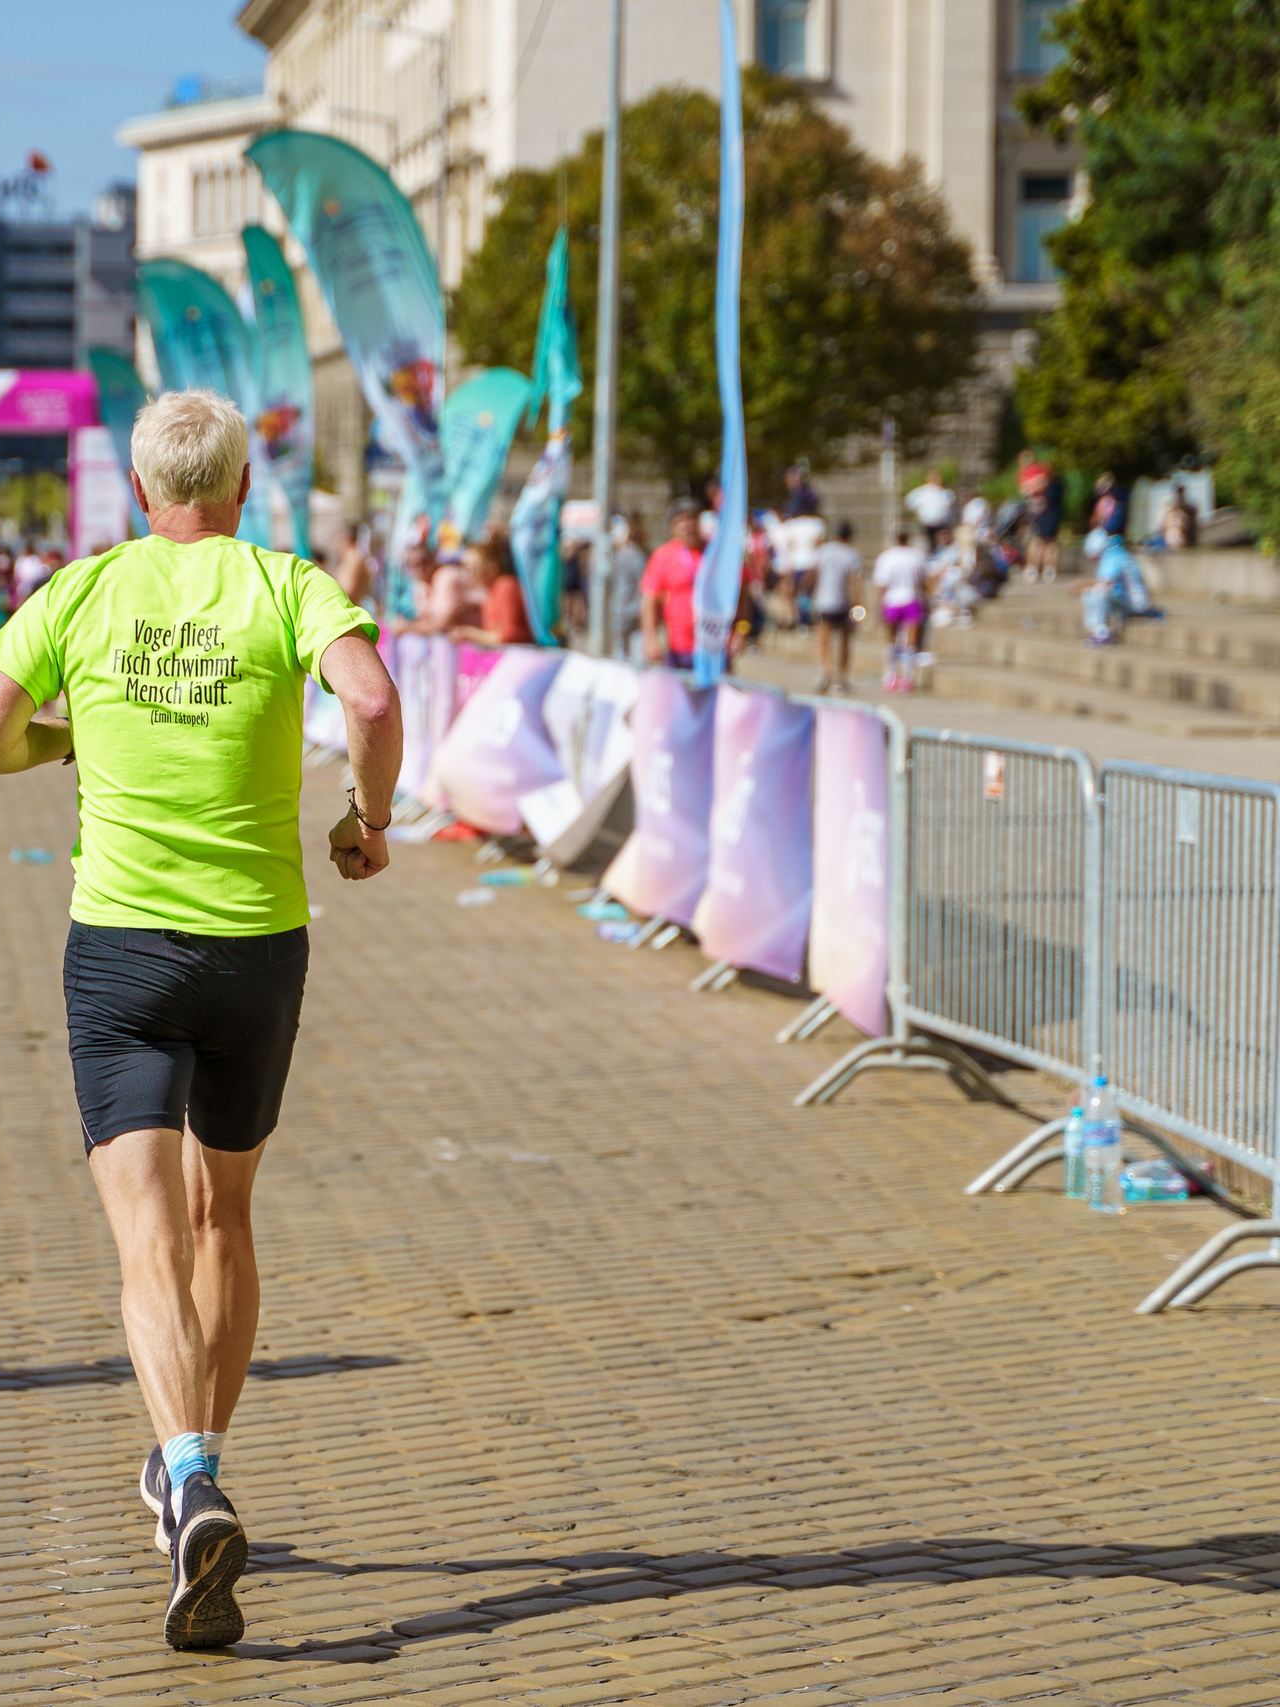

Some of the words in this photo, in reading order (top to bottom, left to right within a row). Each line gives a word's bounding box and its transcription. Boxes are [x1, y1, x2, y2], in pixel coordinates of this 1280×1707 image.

[135, 619, 177, 652] Vogel
[180, 621, 225, 652] fliegt,
[113, 649, 151, 676] Fisch
[157, 652, 243, 681] schwimmt,
[126, 677, 183, 704] Mensch
[189, 679, 233, 706] läuft.
[150, 709, 172, 725] (Emil
[173, 711, 210, 728] Zátopek)
